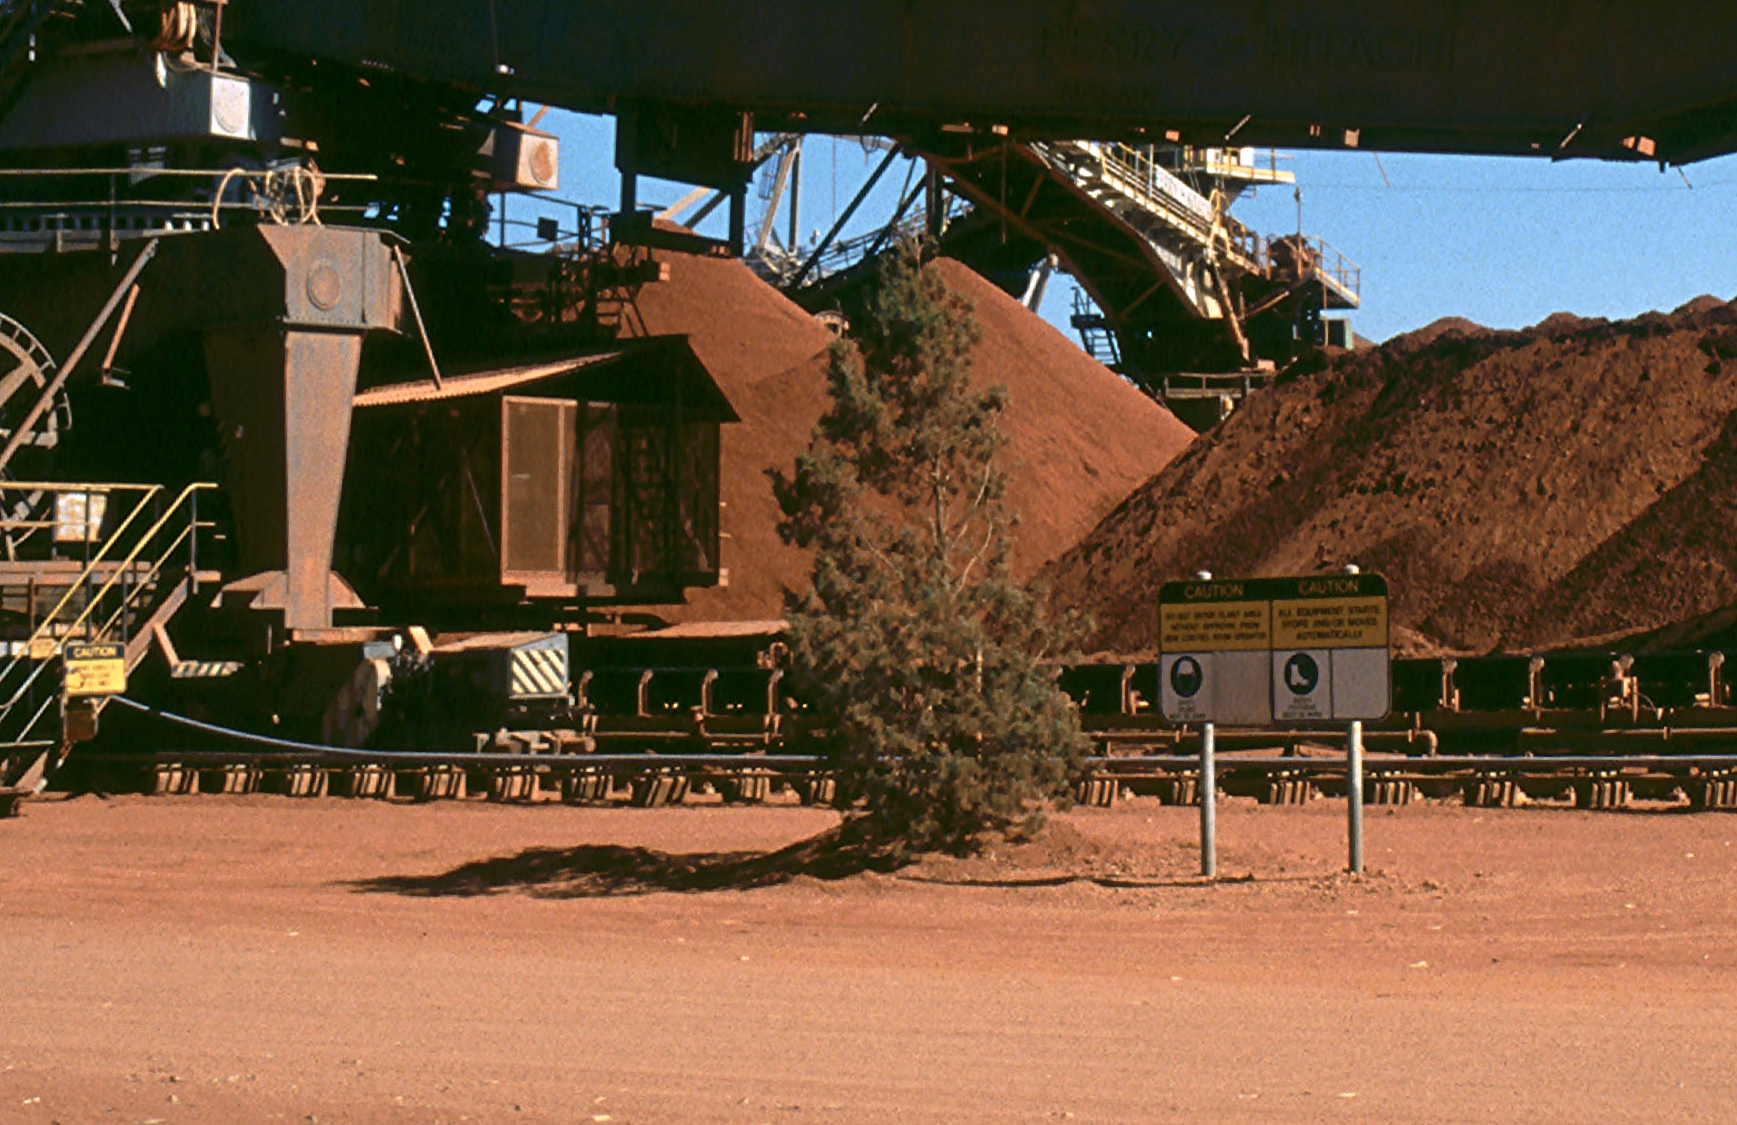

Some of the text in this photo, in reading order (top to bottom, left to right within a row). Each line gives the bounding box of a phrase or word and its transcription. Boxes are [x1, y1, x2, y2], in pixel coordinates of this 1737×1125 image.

[1184, 584, 1244, 599] CAUTION
[1298, 579, 1359, 595] CAUTION
[1296, 606, 1343, 616] EQUIPMENT
[1295, 629, 1363, 640] AUTOMATICALLY
[73, 646, 117, 658] CAUTION
